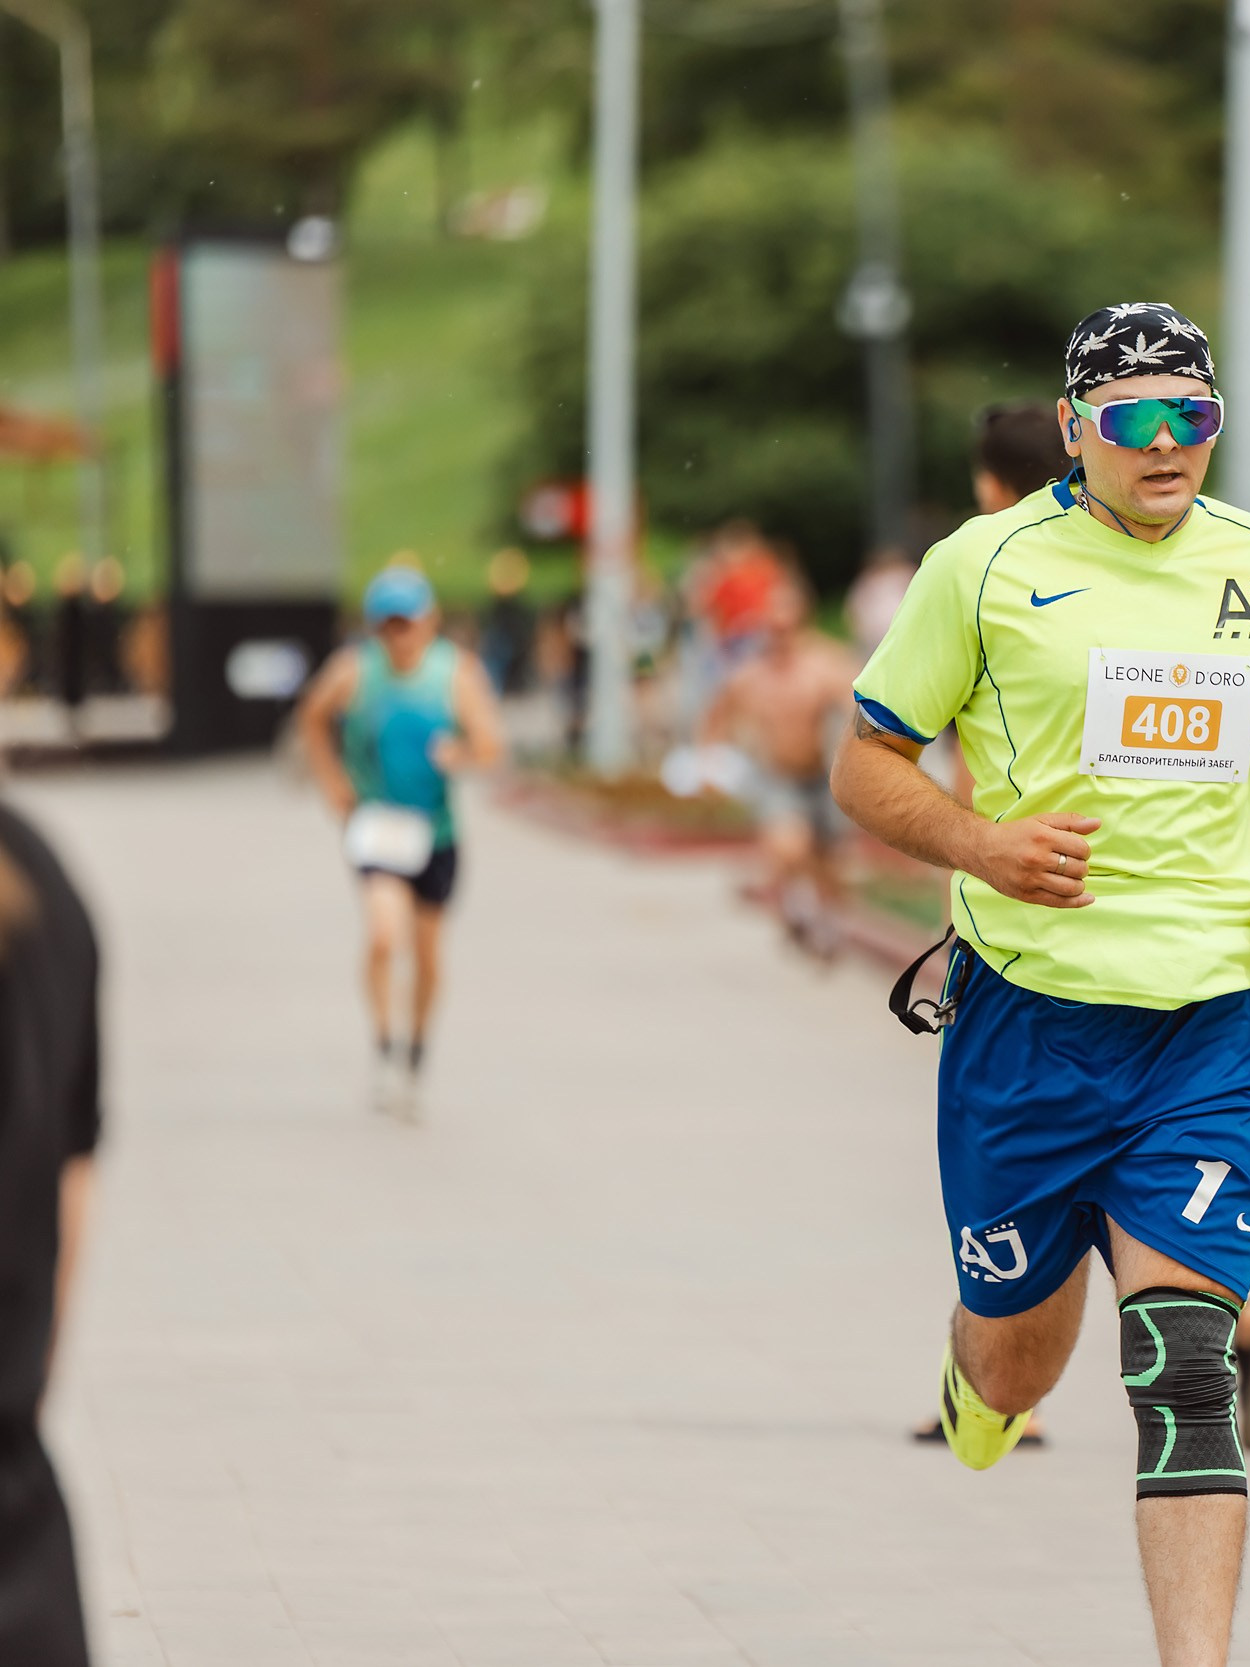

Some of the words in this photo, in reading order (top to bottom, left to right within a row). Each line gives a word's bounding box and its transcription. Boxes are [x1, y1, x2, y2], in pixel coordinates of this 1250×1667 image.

[1105, 666, 1164, 683] LEONE
[1195, 670, 1245, 687] D'ORO
[1131, 703, 1211, 744] 408
[1098, 753, 1207, 768] БЛАГОТВОРИТЕЛЬНЫЙ
[1208, 759, 1235, 769] ЗАБЕГ
[1181, 1159, 1232, 1224] 1
